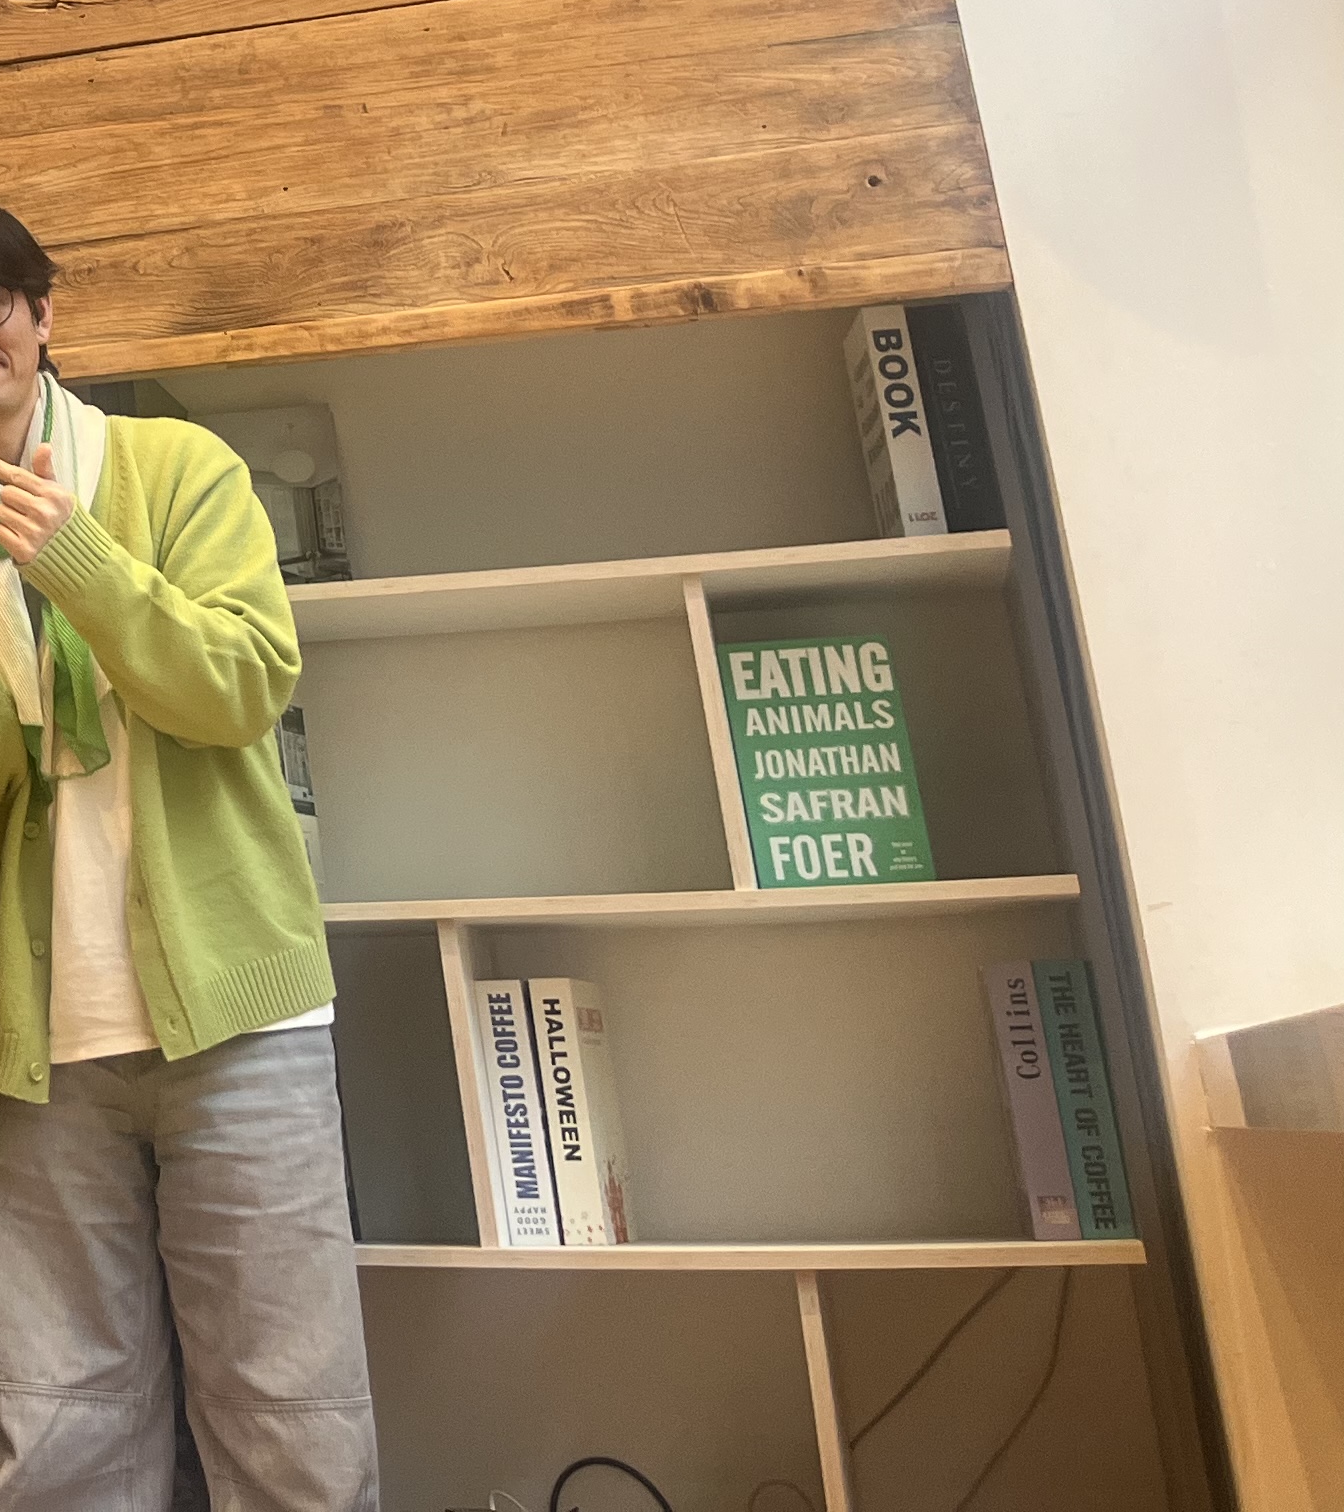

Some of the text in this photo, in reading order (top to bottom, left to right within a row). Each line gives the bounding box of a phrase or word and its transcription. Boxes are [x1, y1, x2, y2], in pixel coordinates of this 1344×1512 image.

[871, 328, 922, 439] BOOK
[728, 642, 894, 701] EATING
[745, 699, 895, 737] ANIMALS
[754, 742, 902, 780] JONATHAN
[760, 785, 910, 823] SAFRAN
[769, 832, 879, 881] FOER
[1006, 977, 1042, 1080] Collins
[486, 992, 541, 1200] MANIFESTO COFFEE
[542, 998, 582, 1162] HALLOWEEN
[1049, 971, 1118, 1230] THE HEART OF COFFEE
